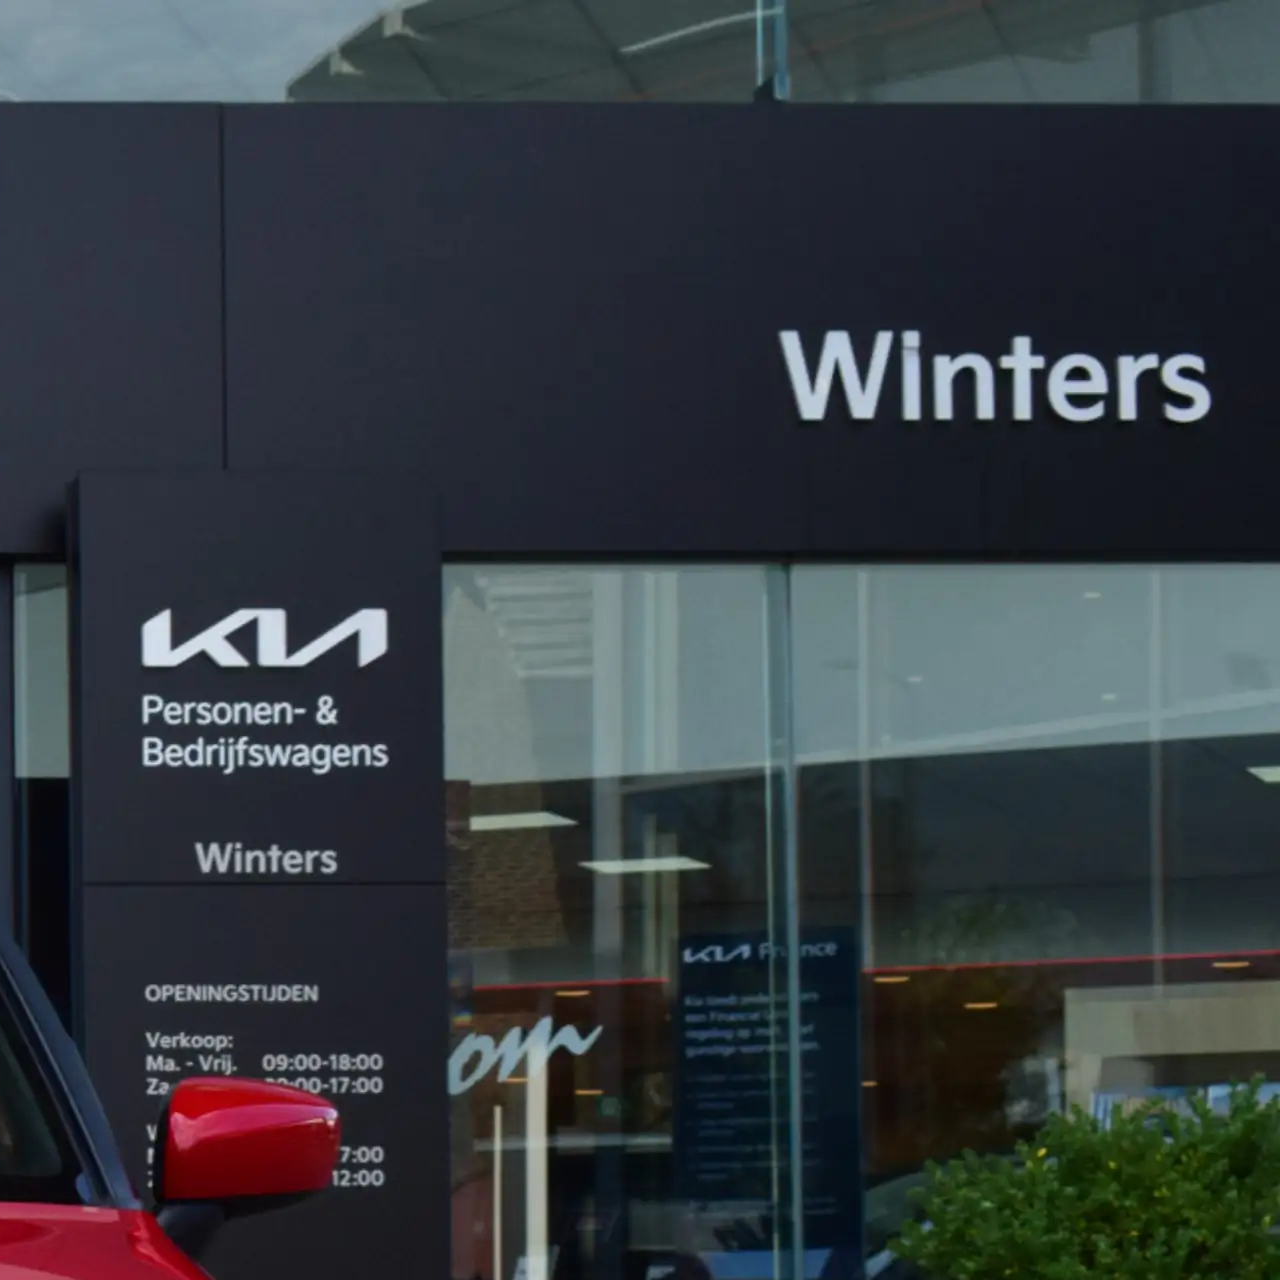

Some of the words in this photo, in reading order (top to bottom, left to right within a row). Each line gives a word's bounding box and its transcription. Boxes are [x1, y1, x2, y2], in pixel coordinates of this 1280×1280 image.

[778, 329, 1212, 423] Winters
[142, 608, 388, 668] KIA
[142, 695, 306, 725] Personen-
[315, 695, 338, 725] &
[142, 736, 389, 775] Bedrijfswagens
[194, 842, 338, 874] Winters
[145, 985, 319, 1002] OPENINGSTIJDEN
[145, 1032, 233, 1051] Verkoop:
[146, 1055, 180, 1071] Ma.
[199, 1054, 237, 1074] Vrij.
[262, 1054, 383, 1071] 09:00-18:00
